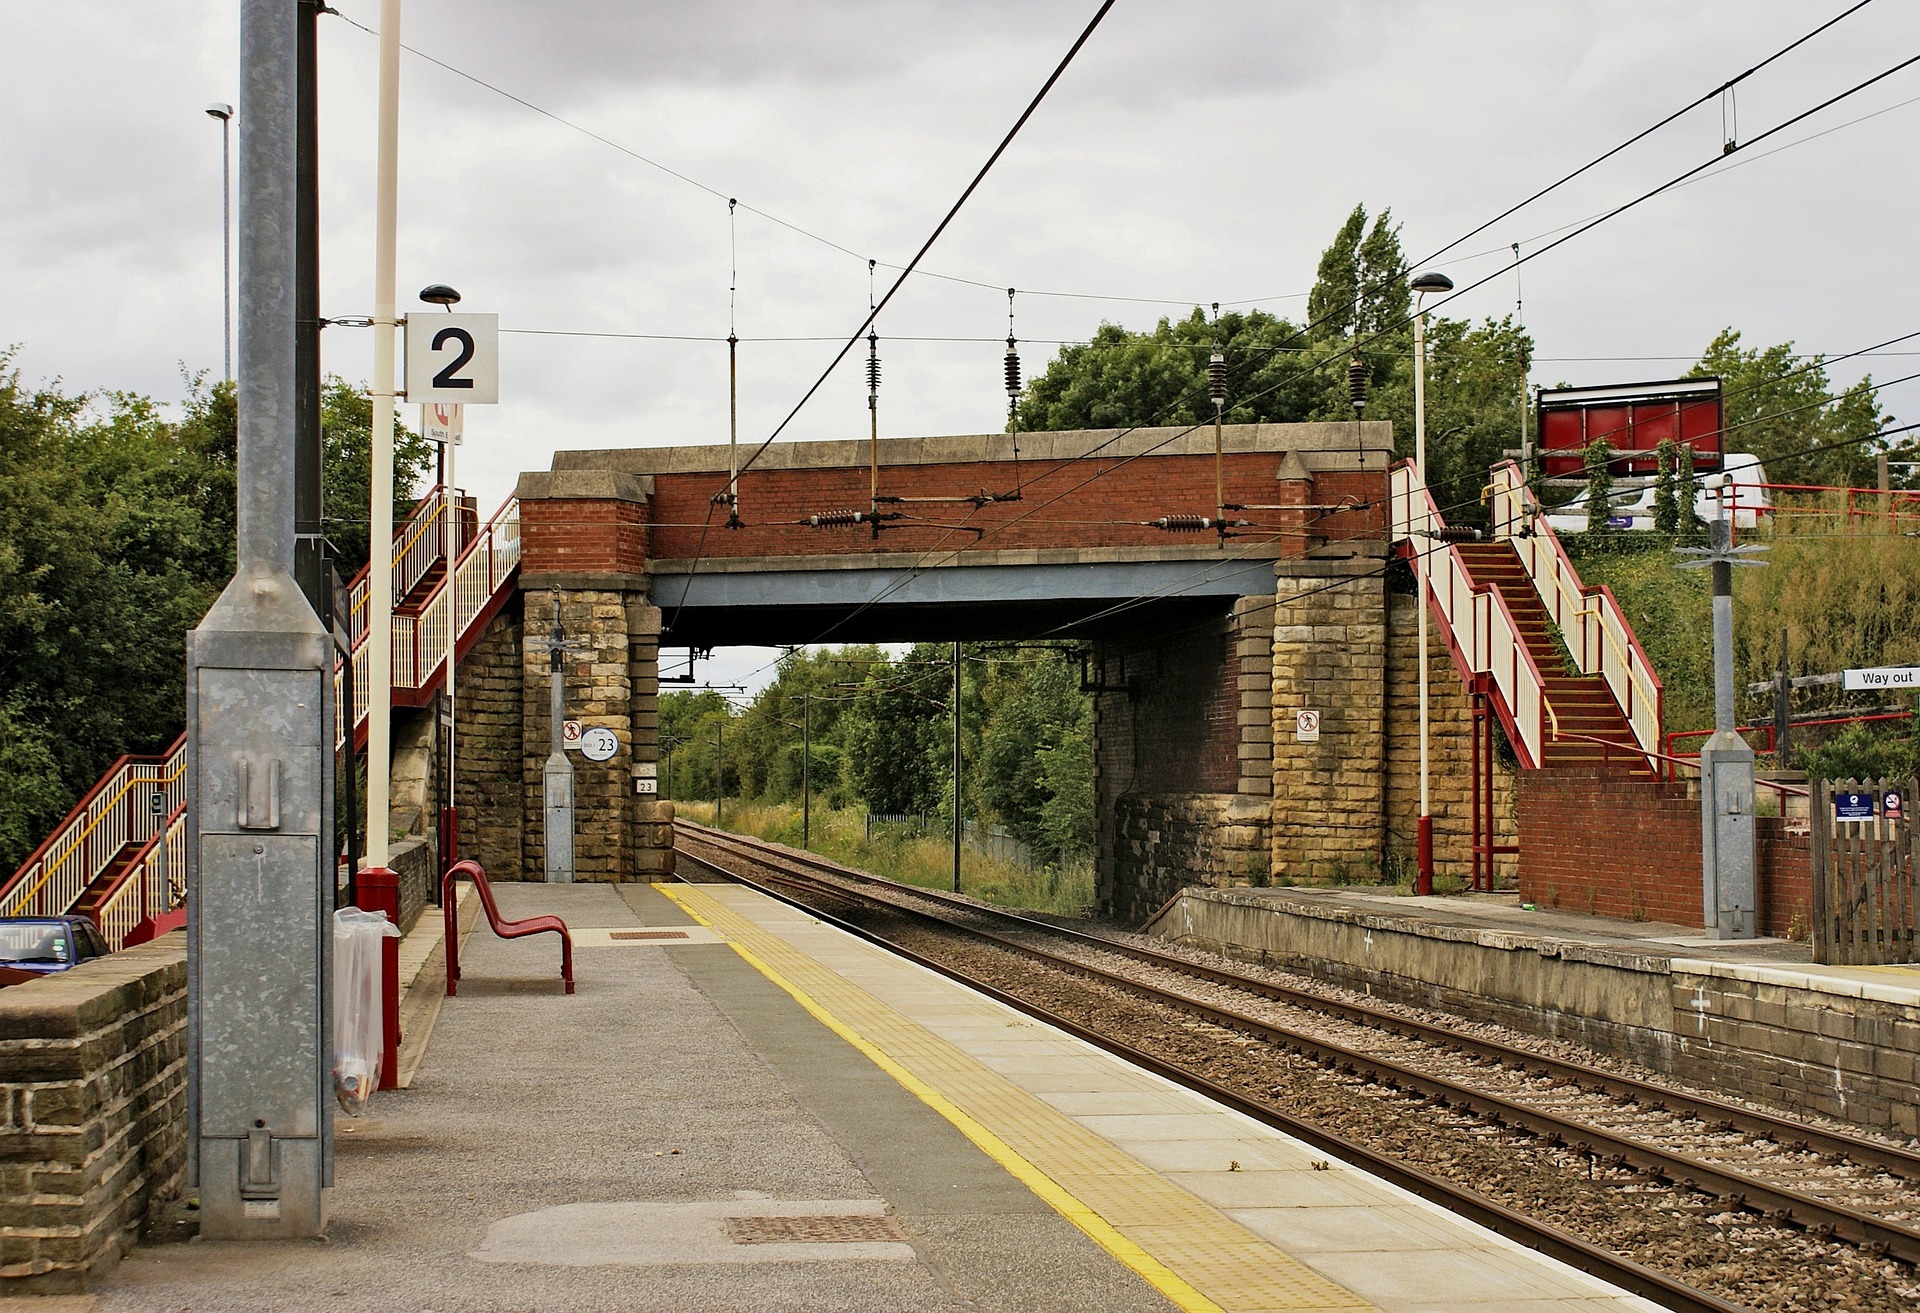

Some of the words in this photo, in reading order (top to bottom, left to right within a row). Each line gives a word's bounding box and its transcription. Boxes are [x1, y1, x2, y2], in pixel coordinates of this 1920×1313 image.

[431, 327, 475, 389] 2
[431, 428, 445, 438] South
[1862, 673, 1889, 686] Way
[1893, 671, 1913, 683] out
[598, 738, 614, 752] 23
[640, 783, 652, 792] 23
